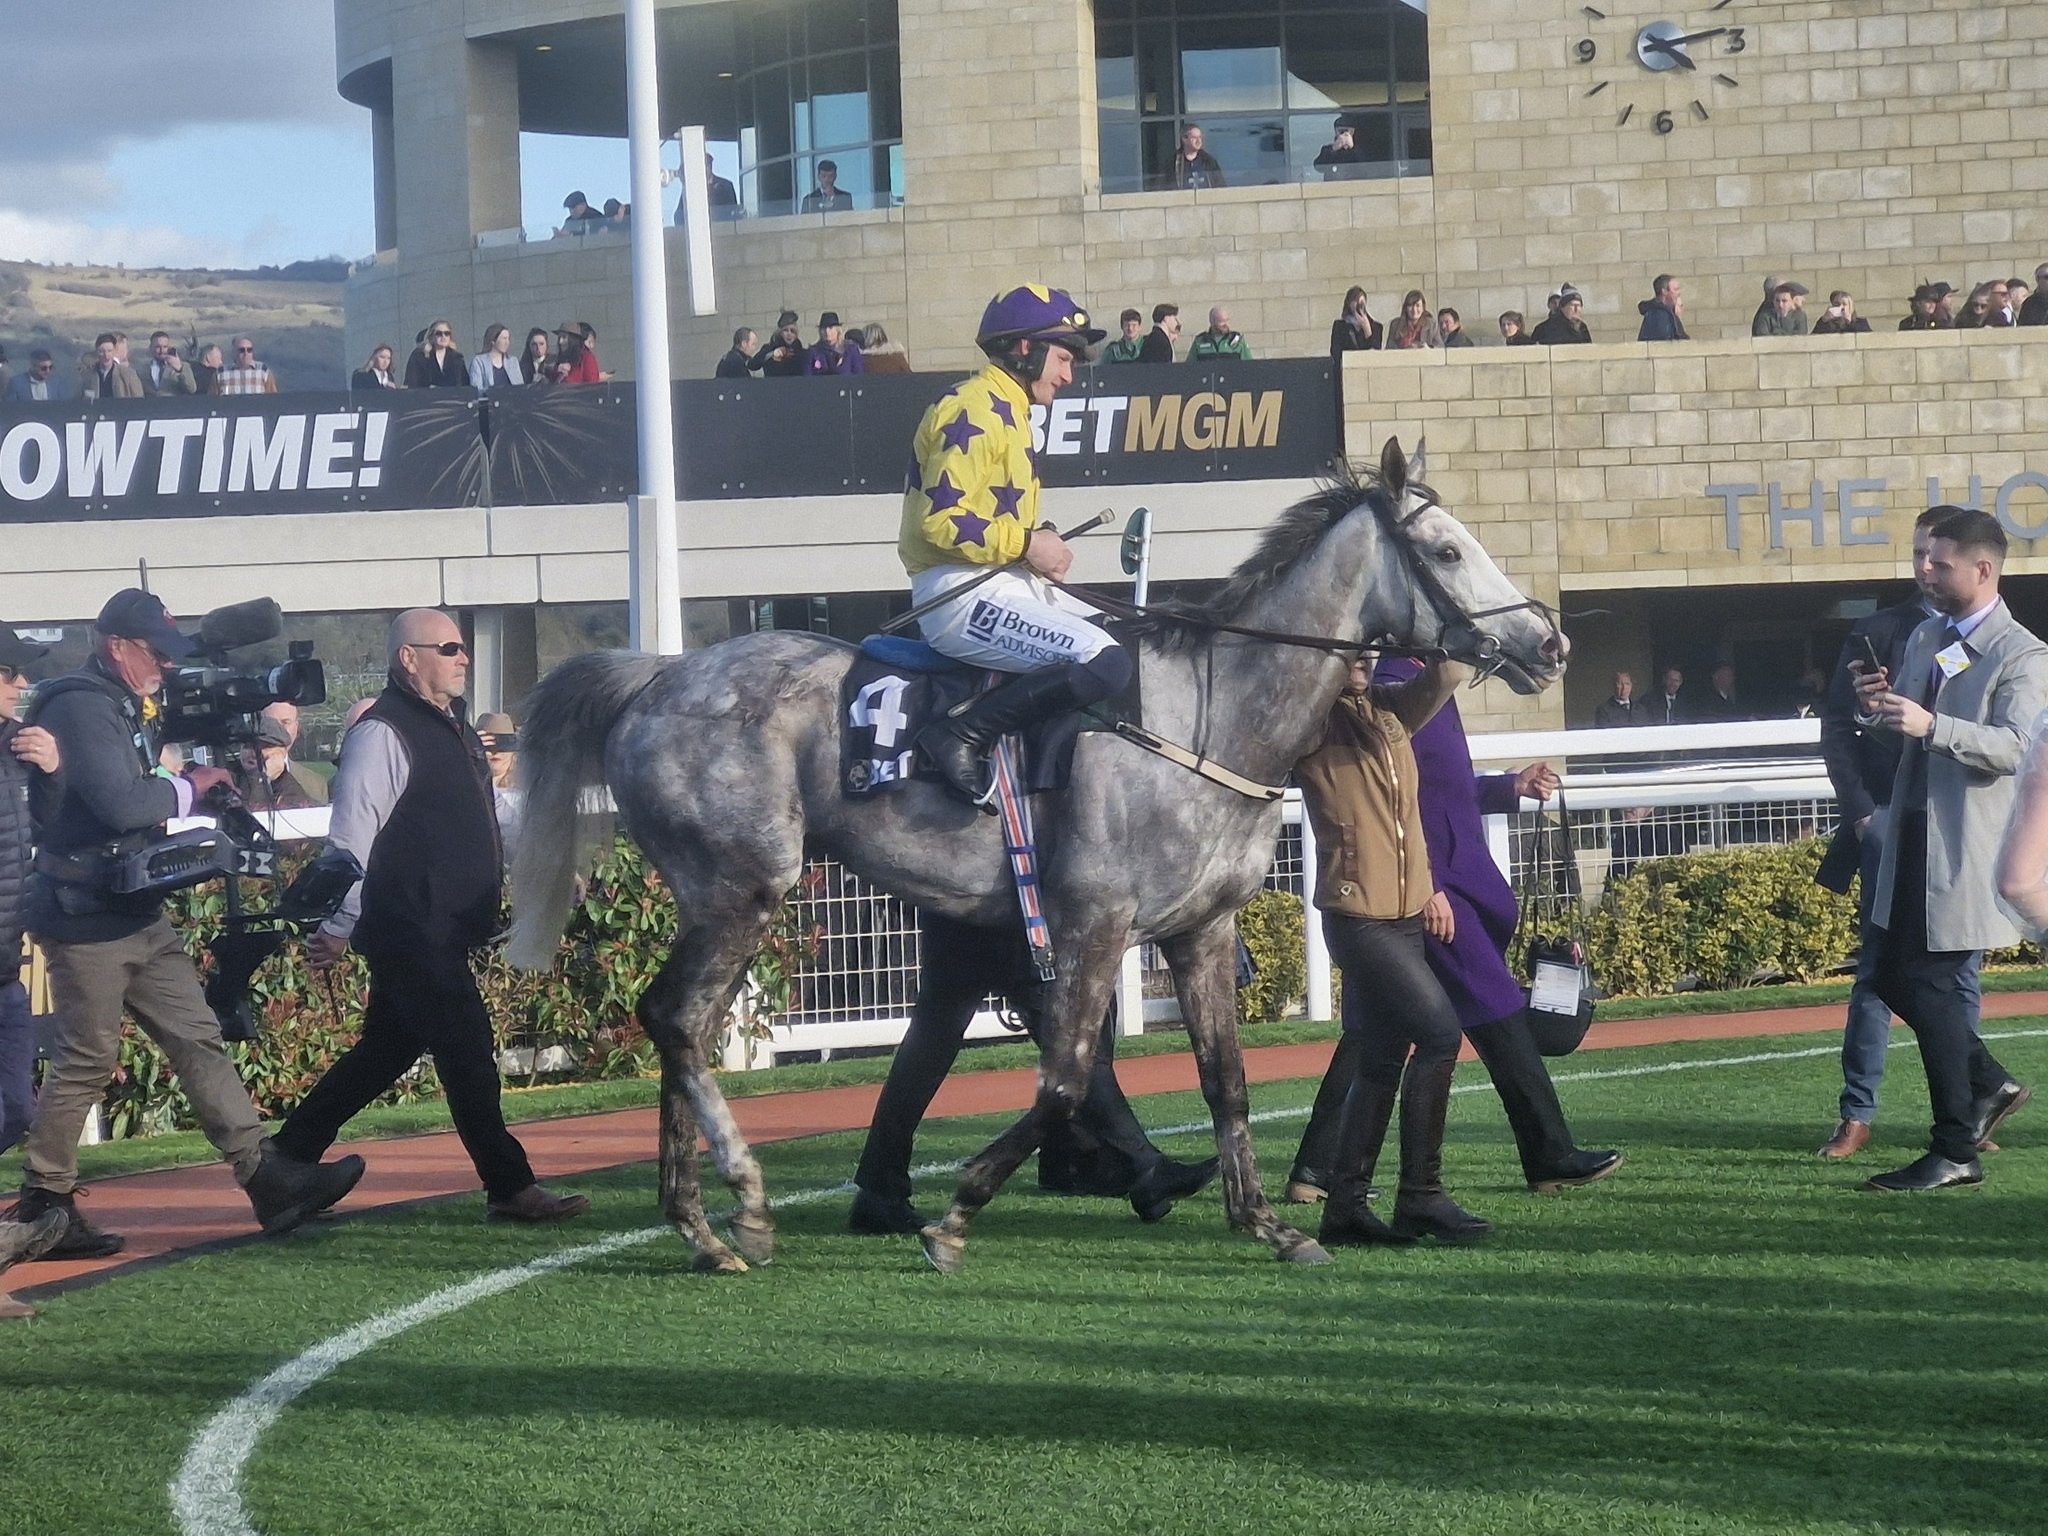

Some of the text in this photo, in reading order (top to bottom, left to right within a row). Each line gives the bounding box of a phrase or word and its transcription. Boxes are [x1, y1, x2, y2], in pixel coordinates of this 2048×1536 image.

[1578, 39, 1596, 62] 9
[1727, 28, 1746, 54] 3
[1656, 110, 1674, 133] 6
[0, 410, 389, 500] OWTIME!
[1704, 478, 1889, 549] THE
[1001, 608, 1075, 650] Brown
[848, 675, 911, 748] 4
